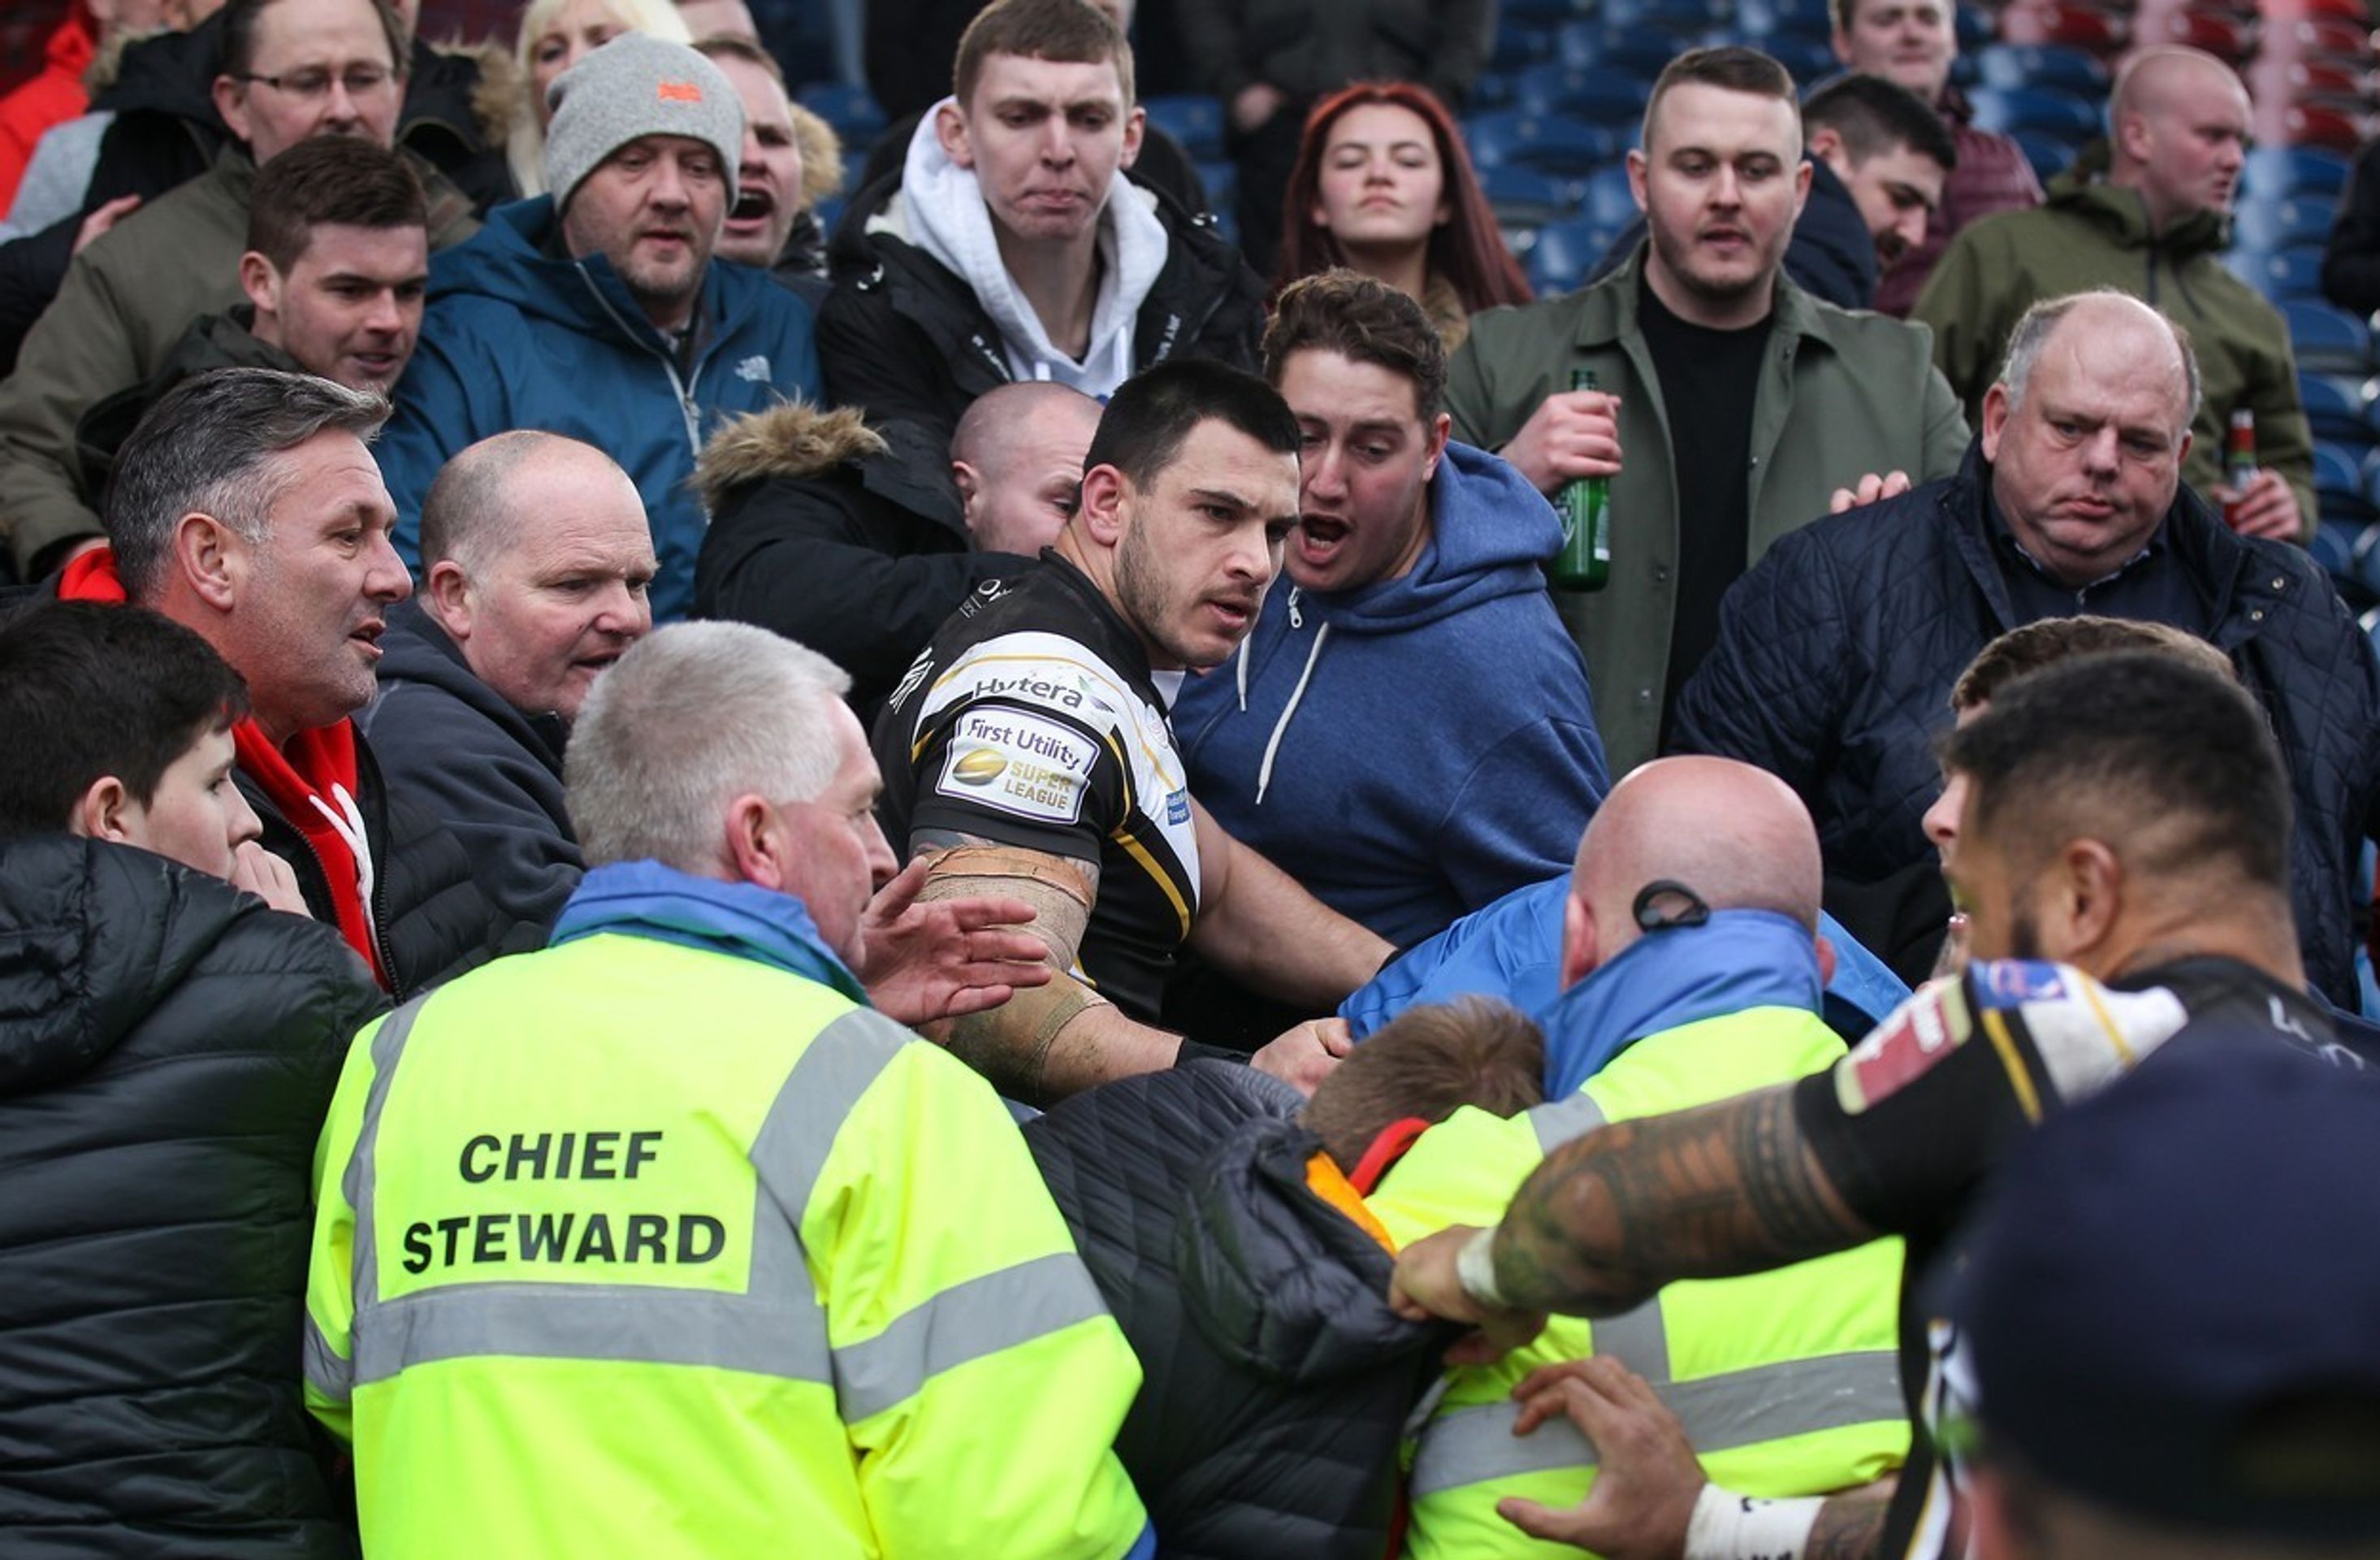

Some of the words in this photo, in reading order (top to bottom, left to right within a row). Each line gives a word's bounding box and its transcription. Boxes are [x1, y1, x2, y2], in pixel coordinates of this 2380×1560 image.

[975, 678, 1083, 708] Hytera
[967, 718, 1013, 744] First
[1016, 730, 1081, 770] Utility
[1004, 779, 1067, 810] LEAGUE
[1011, 760, 1073, 793] SUPER
[459, 1131, 663, 1184] CHIEF
[401, 1213, 726, 1274] STEWARD
